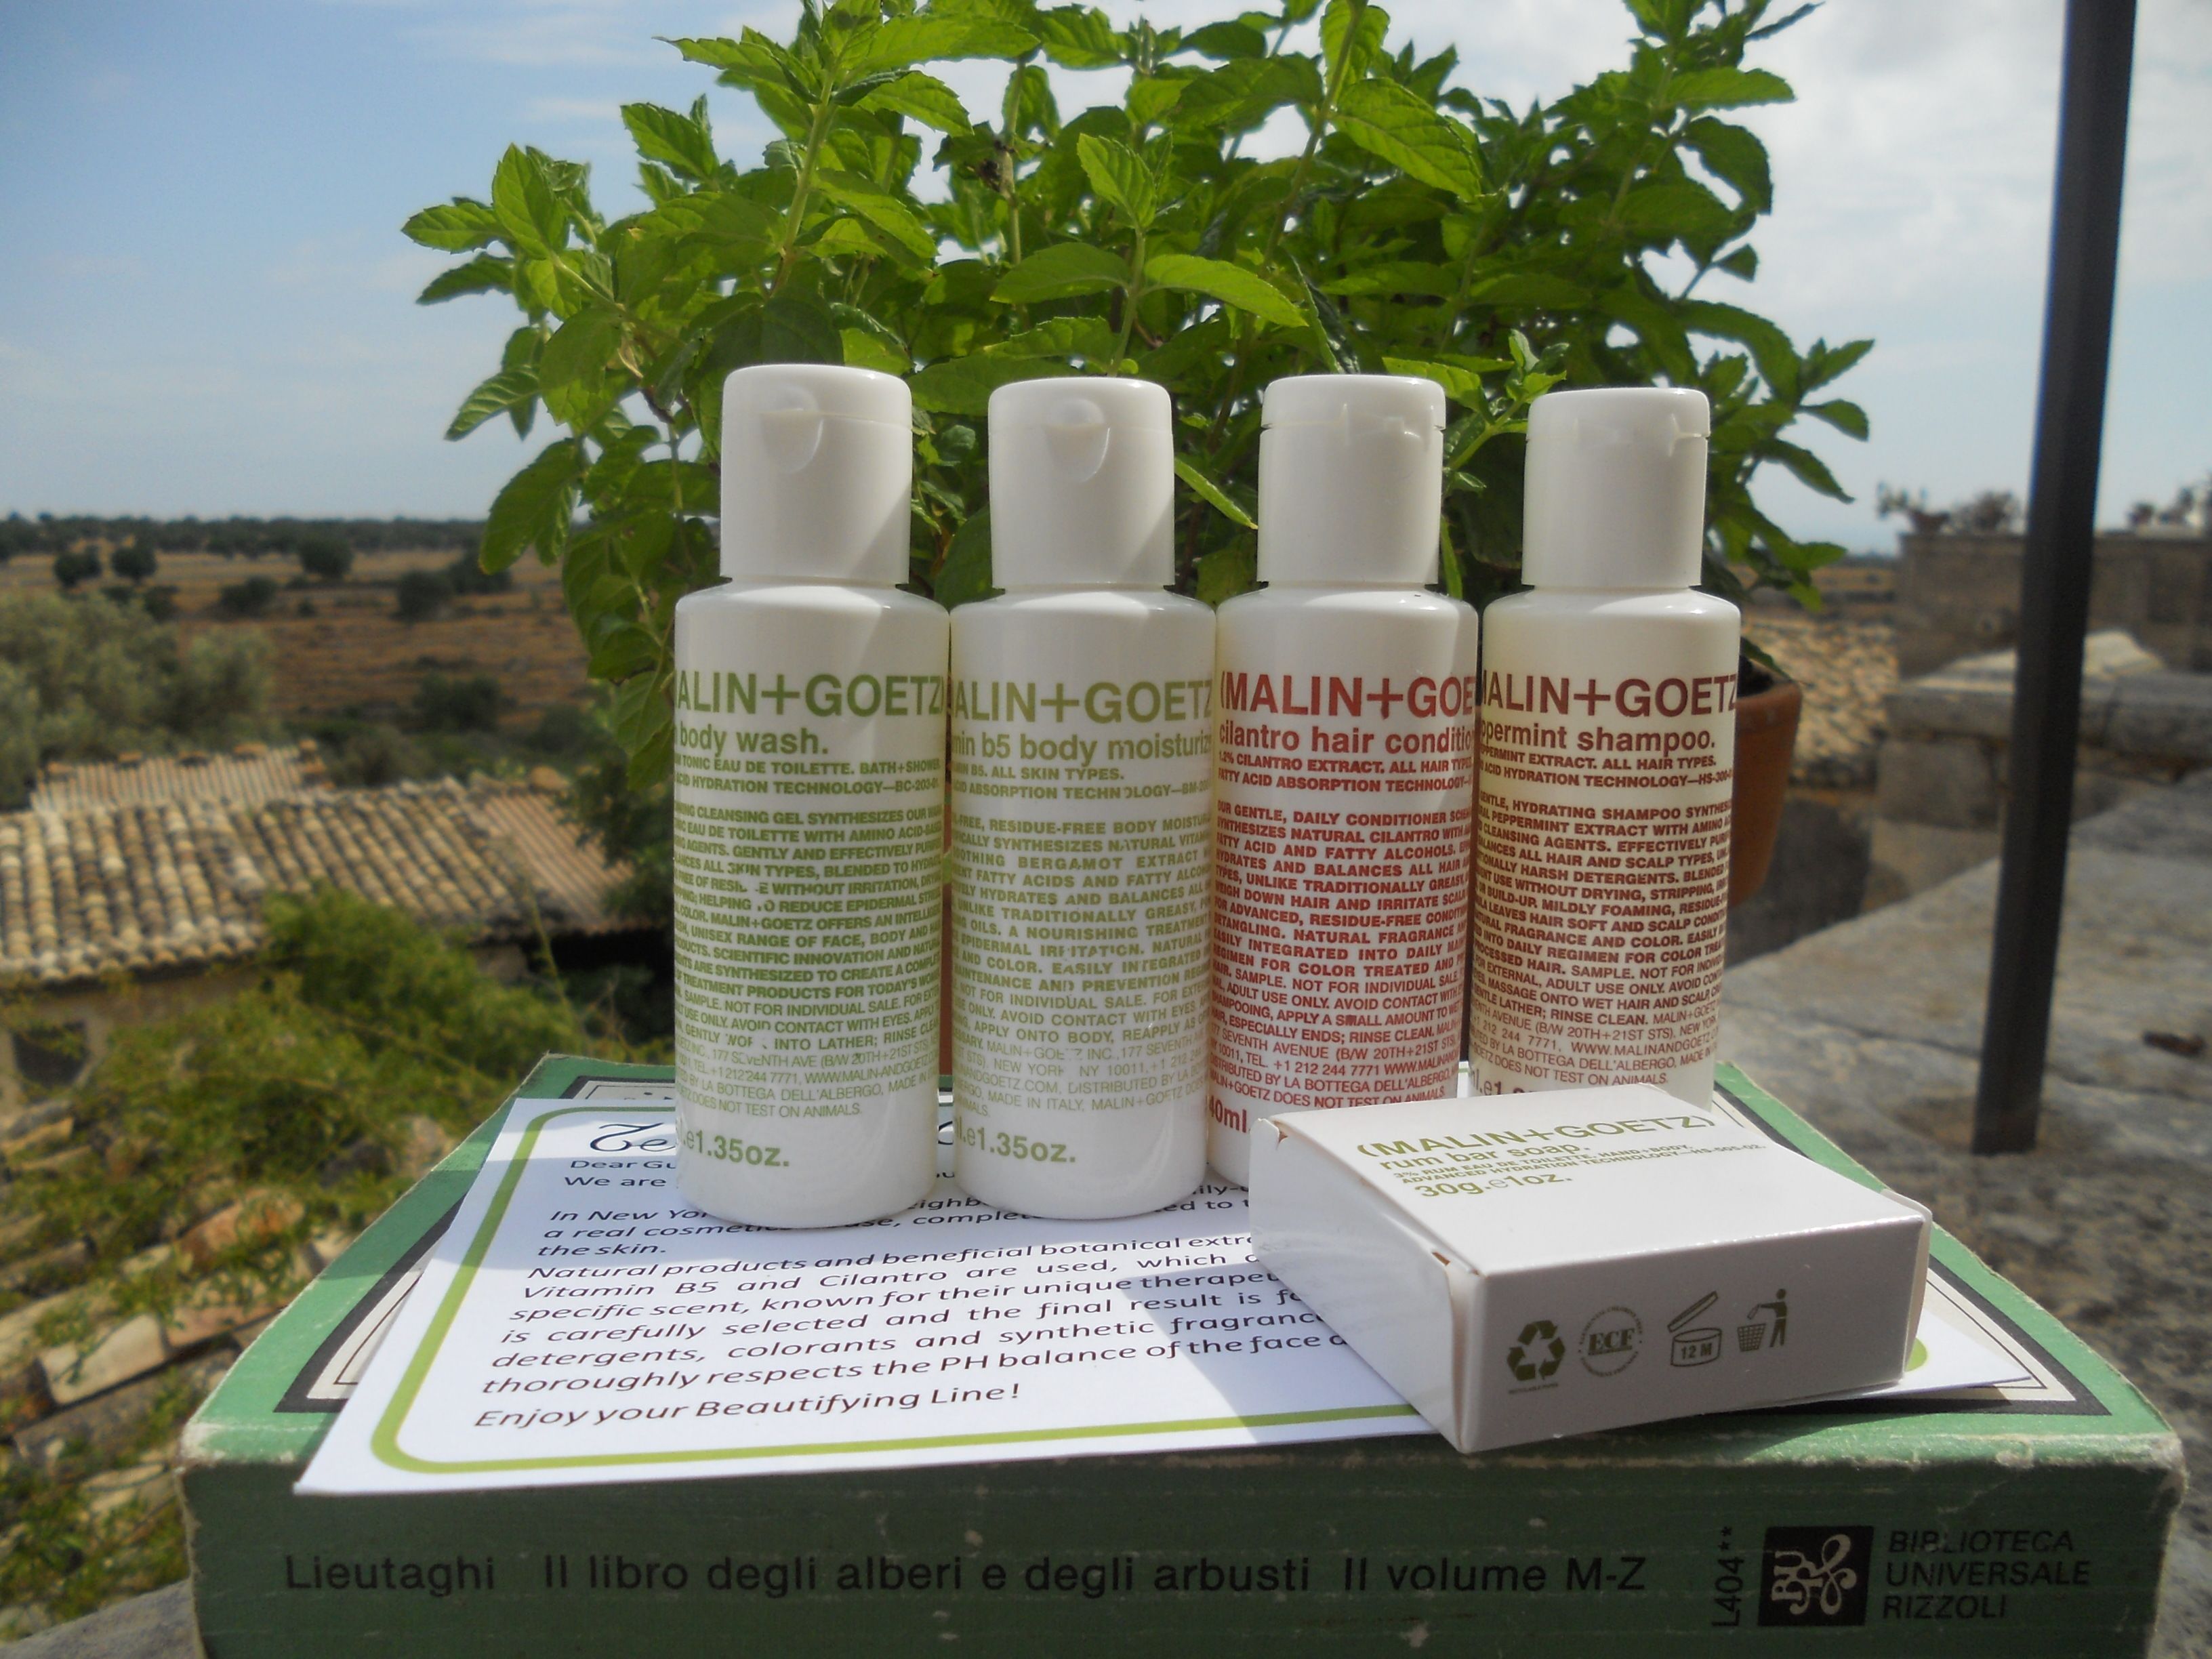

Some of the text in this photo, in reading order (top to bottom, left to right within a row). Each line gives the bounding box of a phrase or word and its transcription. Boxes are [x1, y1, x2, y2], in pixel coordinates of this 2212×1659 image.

[680, 721, 829, 757] body wash.
[1220, 719, 1300, 751] cilantro
[1312, 726, 1375, 754] hair
[1577, 726, 1715, 758] shampoo.
[982, 732, 1010, 758] b5
[1020, 733, 1097, 767] body
[714, 759, 854, 775] EAU DE TOILETTE.
[1237, 755, 1448, 774] CILANTRO EXTRACT. ALL HAIR
[1529, 755, 1717, 770] EXTRACT. ALL HAIR TYPES.
[991, 766, 1124, 780] ALL SKIN TYPES.
[1504, 768, 1580, 786] HYDRATION
[693, 777, 767, 793] HYDRATION
[969, 783, 1057, 799] ABSORPTION
[1242, 774, 1380, 792] ACID ABSORPTION
[697, 806, 903, 825] CLEANSING GEL SYNTHESIZES
[1234, 804, 1447, 827] GENTLE, DAILY CONDITIONER
[1513, 800, 1681, 821] HYDRATING SHAMPOO
[989, 819, 1158, 835] RESIDUE-FREE BODY
[733, 844, 913, 861] GENTLY EFFECTIVELY
[1617, 837, 1706, 853] EFFECTIVELY
[1018, 856, 1123, 871] BERGAMOT
[1314, 864, 1403, 878] BALANCES
[1023, 872, 1171, 888] ACIDS AND FATTY
[1303, 880, 1425, 894] TRADITIONALLY
[1573, 872, 1679, 885] DETERGENTS.
[1002, 907, 1136, 923] TRADITIONALLY
[1309, 912, 1421, 928] RESIDUE-FREE
[1026, 926, 1139, 941] NOURISHING
[1298, 963, 1429, 977] COLOR TREATED
[787, 1002, 865, 1017] INDIVIDUAL
[1597, 1012, 1649, 1026] CLEAN.
[1017, 1027, 1059, 1042] ONTO
[779, 1102, 862, 1118] ON ANIMALS.
[1357, 1115, 1715, 1157] (MALIN+GOETZ)
[570, 1160, 638, 1168] Dear
[1380, 1144, 1590, 1170] rum bar soap.
[1424, 1166, 1458, 1175] RUM
[1519, 1154, 1597, 1165] TOILETTE.
[564, 1176, 611, 1187] We
[1402, 1163, 1578, 1183] ADVANCED HYDRATION
[1204, 1200, 1233, 1210] to
[550, 1210, 578, 1221] In
[588, 1210, 659, 1221] New
[544, 1230, 564, 1238] a
[573, 1227, 636, 1237] real
[527, 1237, 1181, 1279] Natural products and beneficial botanical
[538, 1244, 667, 1256] the skin.
[524, 1252, 1227, 1299] Vitamin B5 and Cilantro are used, which
[508, 1277, 1133, 1322] specific scent, known for their unique
[501, 1292, 1262, 1344] is carefully selected and the final result is
[491, 1346, 706, 1368] detergents,
[727, 1337, 897, 1359] colorants
[916, 1330, 981, 1348] and
[998, 1320, 1155, 1344] synthetic
[1681, 1343, 1712, 1360] 12 M
[483, 1334, 1321, 1394] thoroughly respects the PH balance of the face
[474, 1383, 1020, 1429] Enjoy your Beautifying Line!
[1888, 1530, 2074, 1553] BIBLIOTECA
[285, 1555, 494, 1597] Lieutaghi
[589, 1555, 689, 1591] libro
[706, 1556, 816, 1599] degli
[836, 1557, 962, 1591] alberi
[982, 1563, 1006, 1591] e
[1025, 1557, 1133, 1599] degli
[1153, 1557, 1309, 1592] arbusti
[1387, 1557, 1546, 1591] volume
[1566, 1557, 1645, 1591] M-Z
[1885, 1560, 2090, 1586] UNIVERSALE
[1882, 1594, 2007, 1618] RIZZOLI
